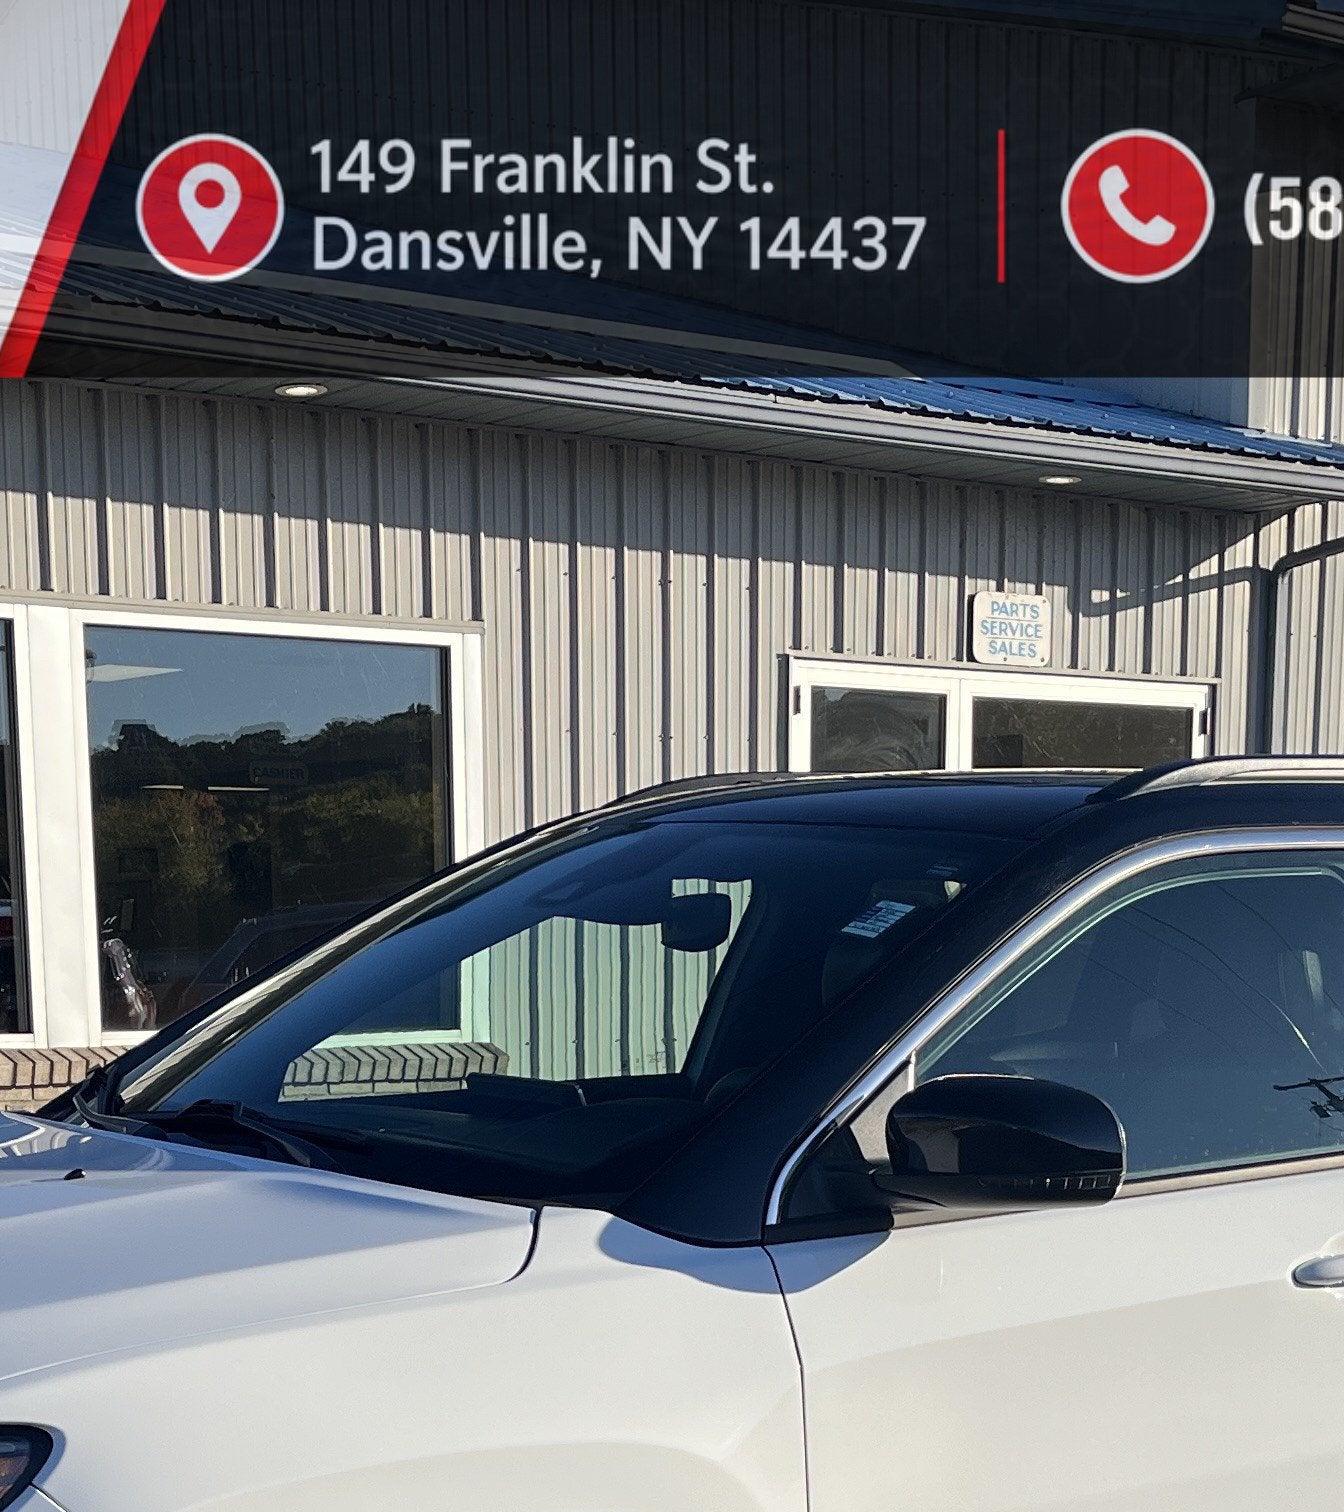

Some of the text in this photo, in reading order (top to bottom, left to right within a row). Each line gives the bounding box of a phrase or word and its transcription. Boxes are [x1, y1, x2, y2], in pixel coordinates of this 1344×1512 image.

[991, 601, 1040, 619] PARTS
[980, 620, 1043, 638] SERVICE
[988, 640, 1037, 658] SALES
